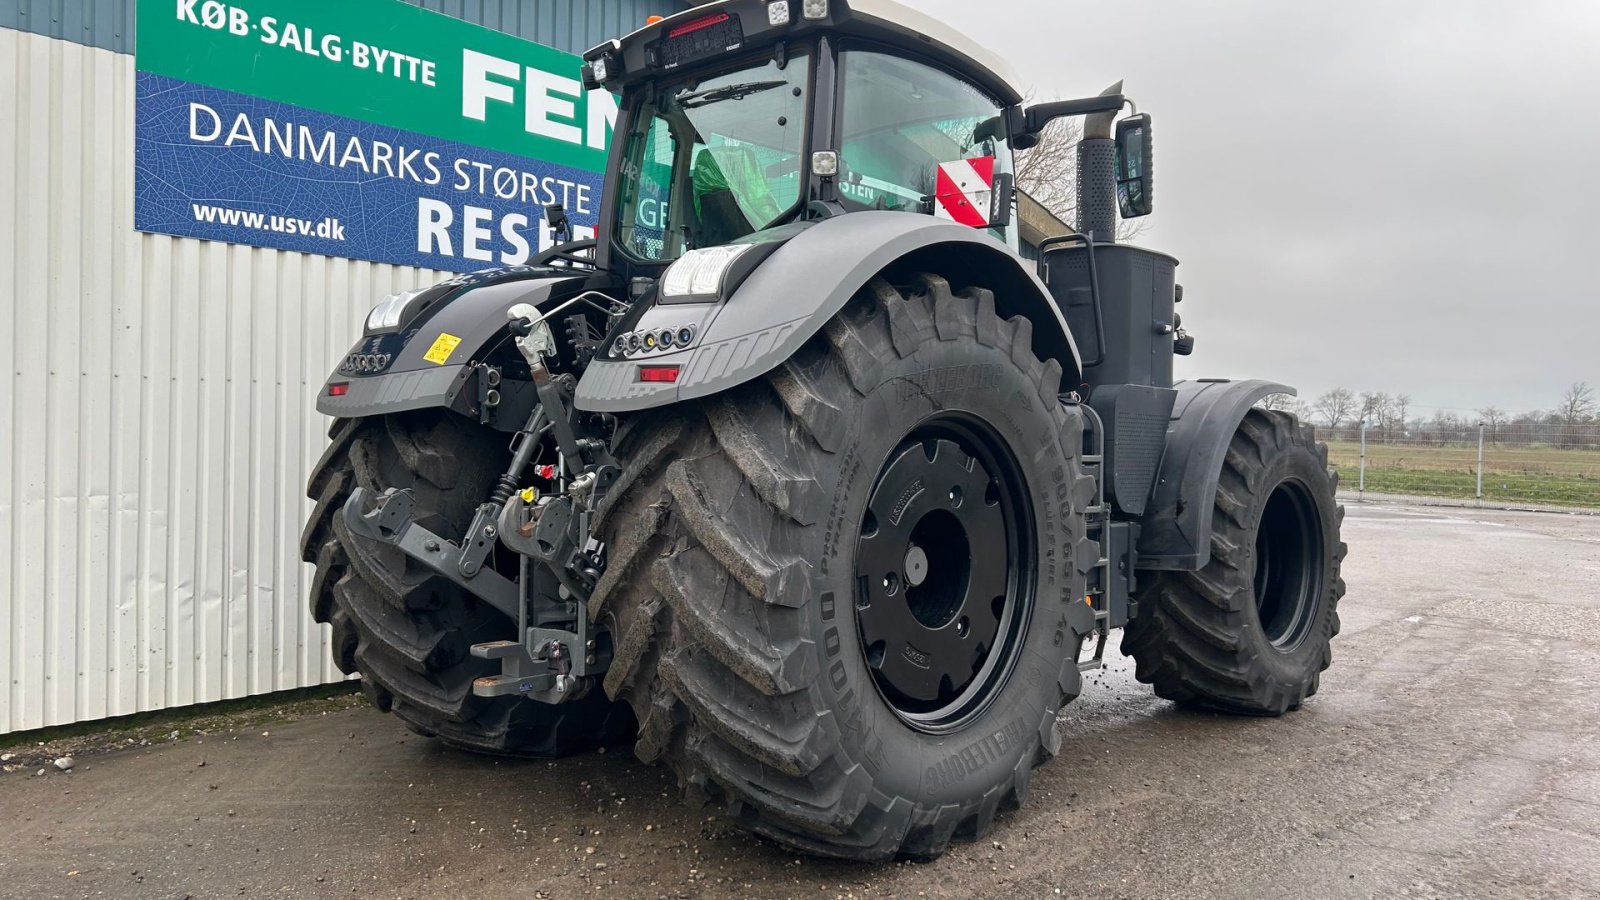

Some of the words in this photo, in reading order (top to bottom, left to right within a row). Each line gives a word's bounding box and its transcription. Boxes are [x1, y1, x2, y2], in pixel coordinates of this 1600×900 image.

[189, 102, 442, 185] DANMARKS
[454, 158, 591, 215] STØRSTE
[192, 203, 345, 241] www.usv.dk
